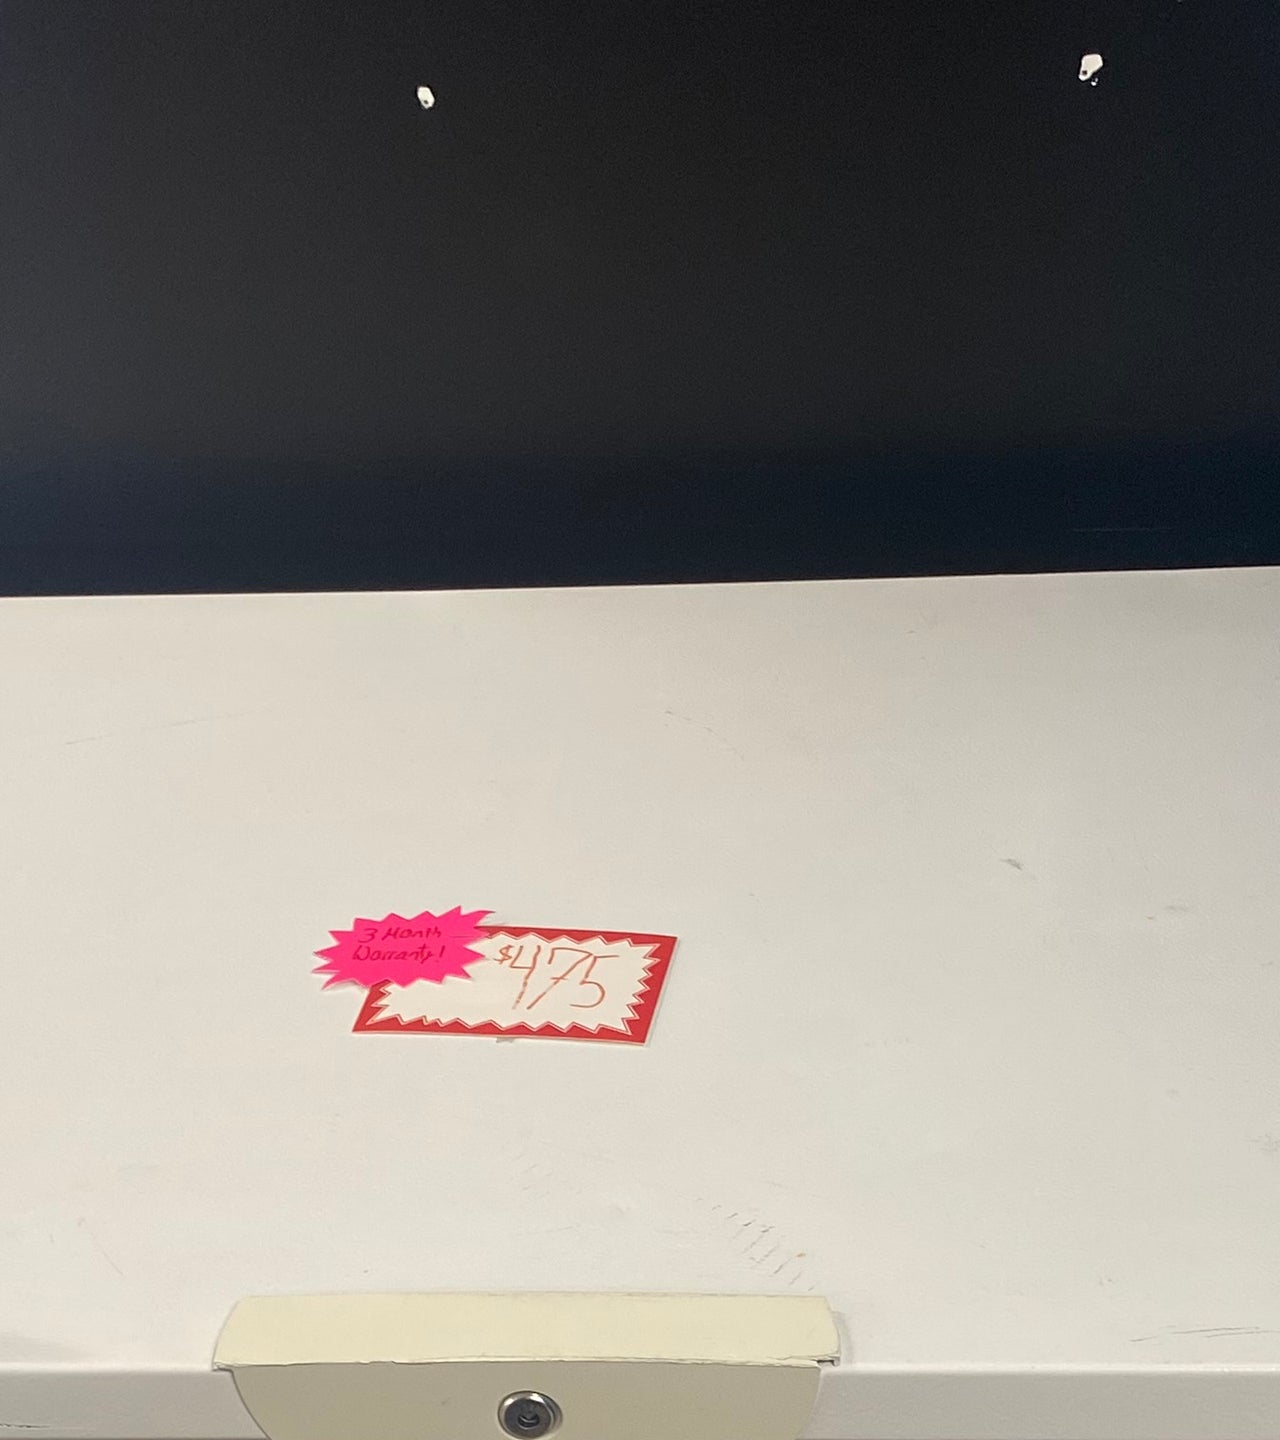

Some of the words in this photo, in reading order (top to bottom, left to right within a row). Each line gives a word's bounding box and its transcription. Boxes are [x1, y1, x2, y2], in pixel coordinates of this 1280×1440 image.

[358, 927, 375, 941] 3
[382, 926, 442, 941] Month
[351, 945, 446, 966] Warranty!
[493, 944, 620, 1010] $475
